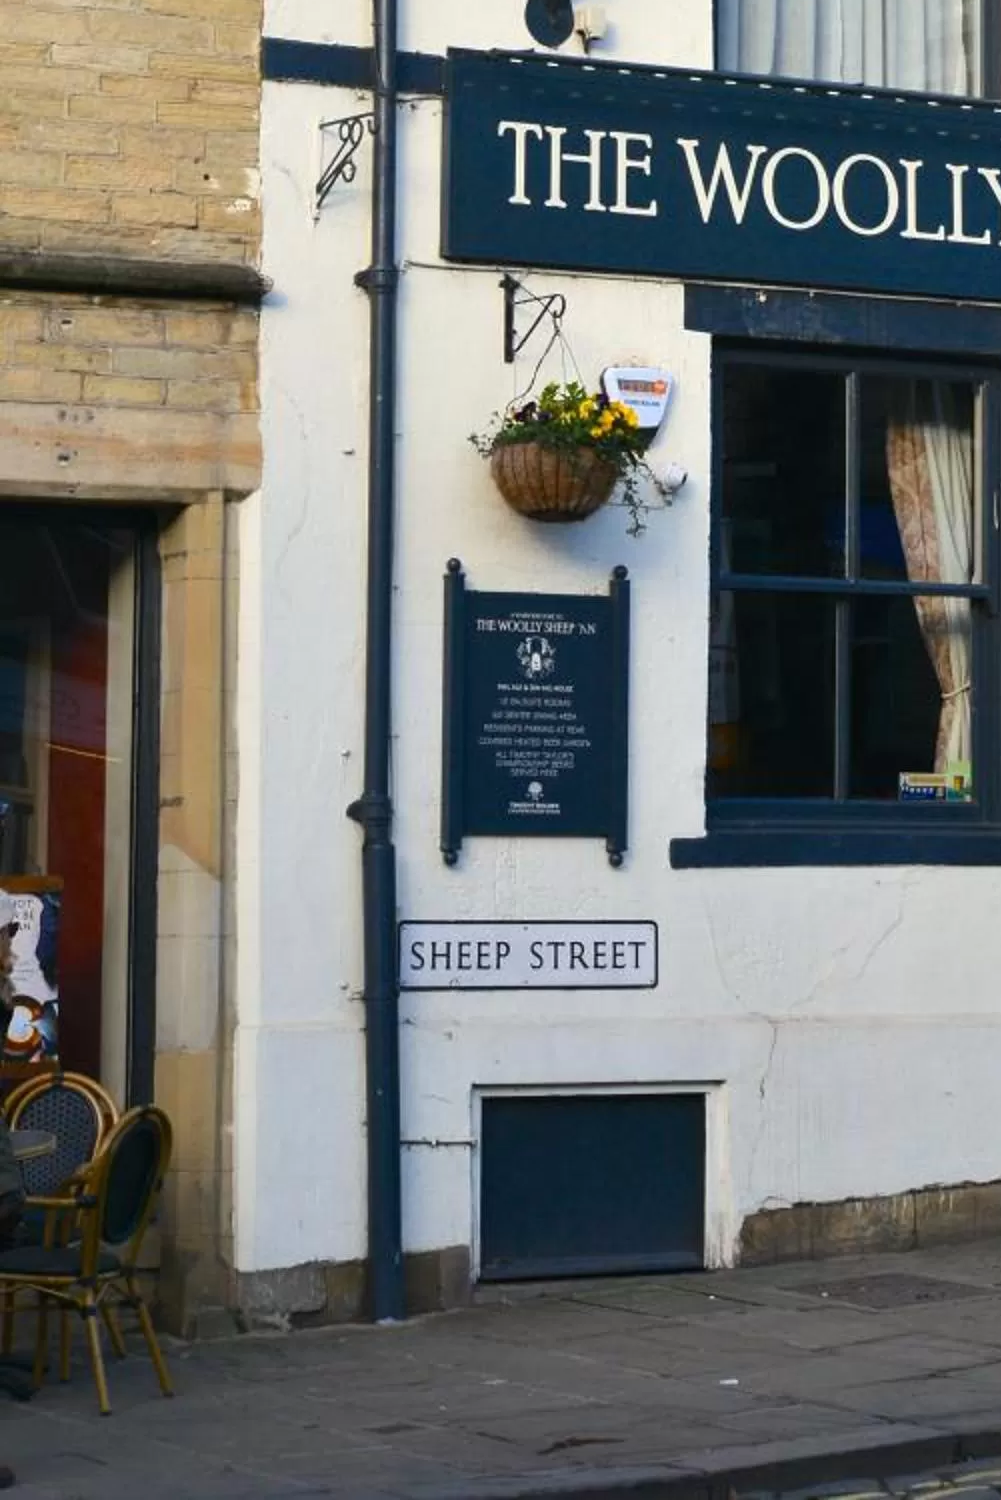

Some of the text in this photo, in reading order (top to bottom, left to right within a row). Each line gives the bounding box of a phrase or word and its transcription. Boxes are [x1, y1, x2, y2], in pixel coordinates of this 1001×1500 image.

[497, 120, 658, 218] THE
[410, 941, 647, 971] SHEEP STREET
